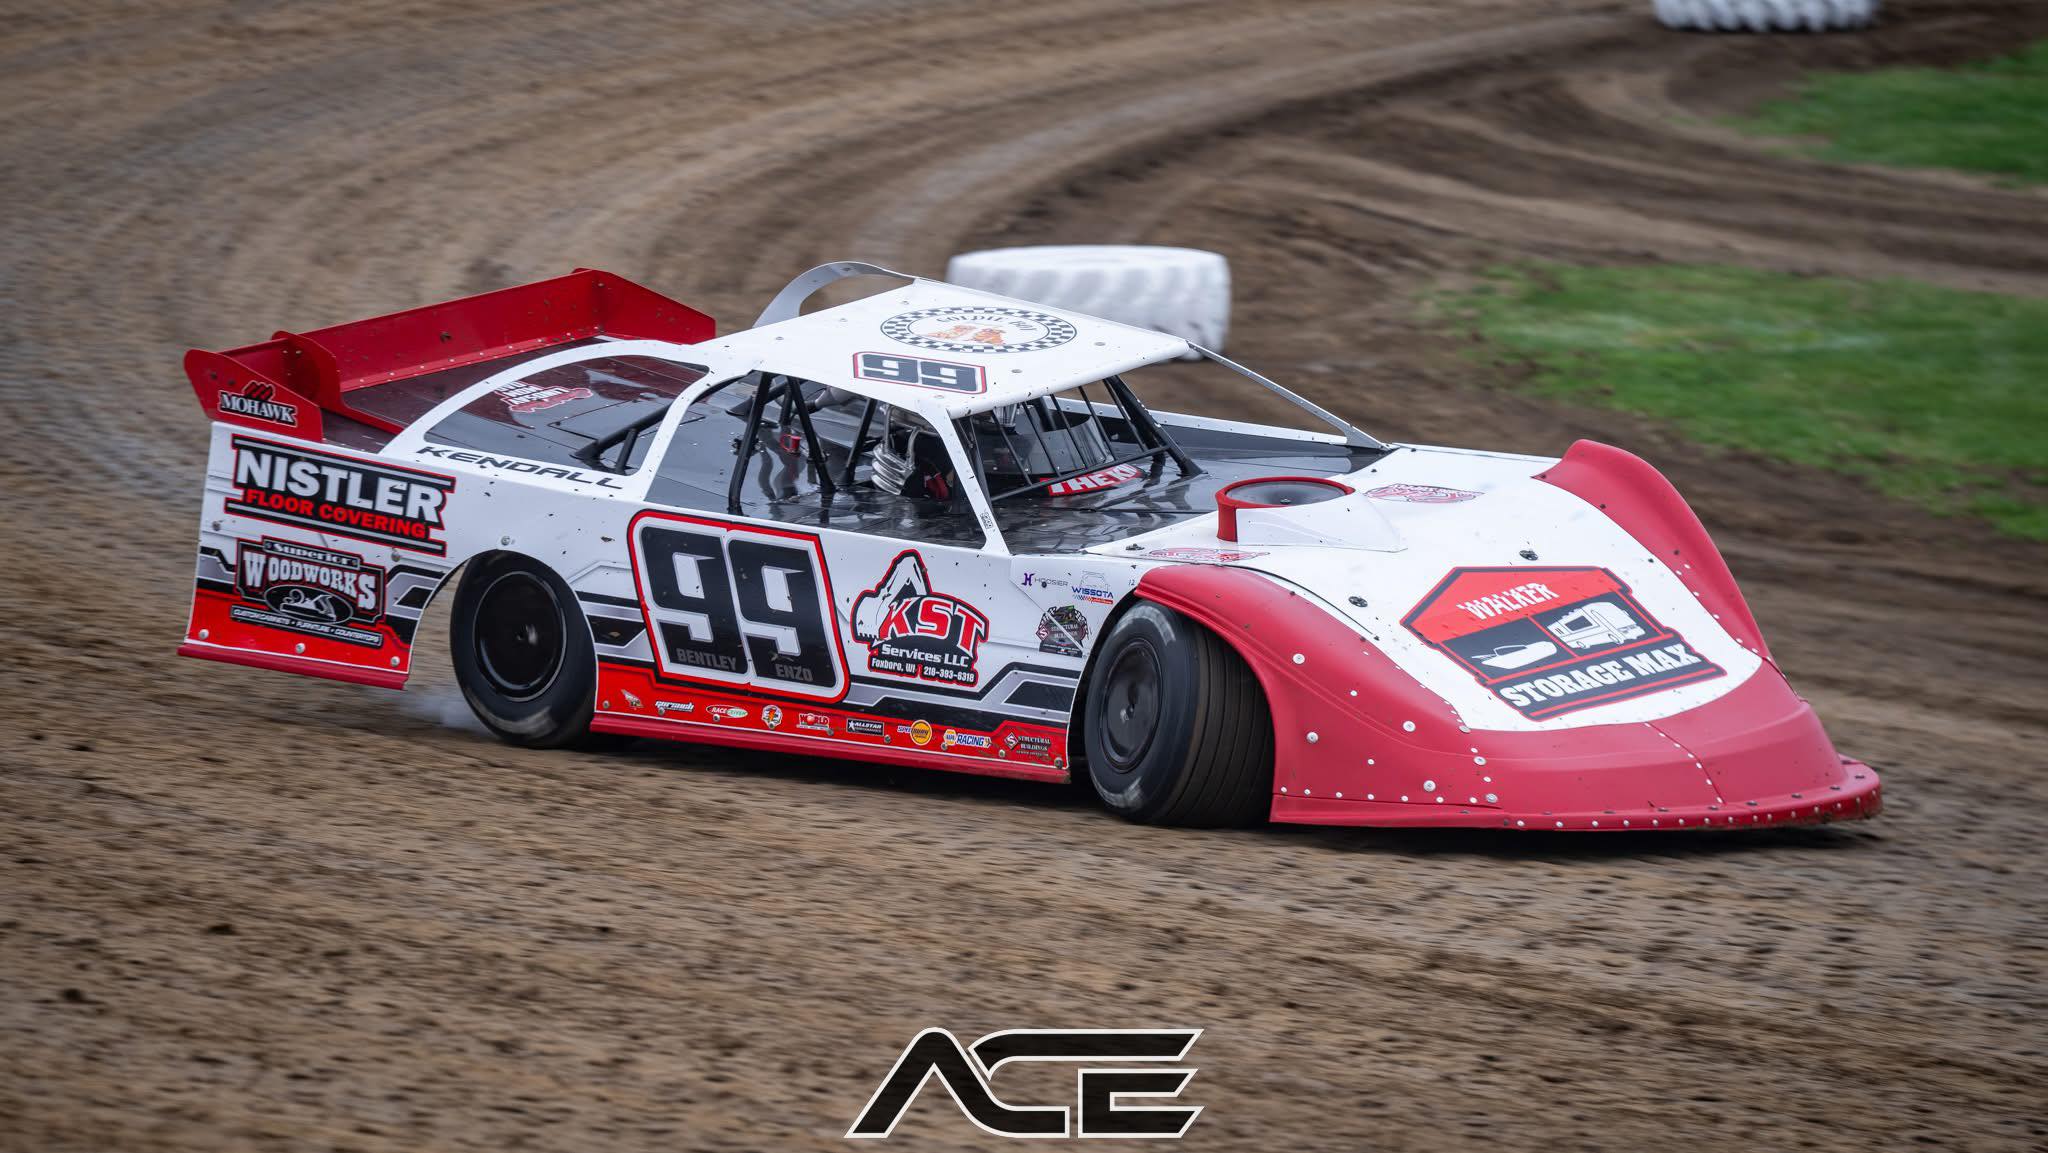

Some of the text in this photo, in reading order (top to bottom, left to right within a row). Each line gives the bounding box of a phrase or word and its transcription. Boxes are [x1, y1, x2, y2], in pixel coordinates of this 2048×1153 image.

[862, 354, 977, 391] 99
[221, 394, 294, 422] MOHAWK
[416, 446, 623, 489] KENDALL
[237, 450, 443, 523] NISTLER
[246, 489, 426, 538] FLOOR COVERING
[273, 543, 349, 564] Superior
[243, 551, 376, 610] WOODWORKS
[1072, 586, 1114, 599] WISSOTA
[640, 526, 837, 687] 99
[1456, 583, 1560, 620] WALKER
[878, 597, 985, 658] KST
[676, 647, 736, 671] BENTLEY
[775, 664, 813, 682] ENZO
[881, 643, 969, 667] Services LLC
[1500, 644, 1701, 707] STORAGE MAX
[957, 734, 985, 746] RACING
